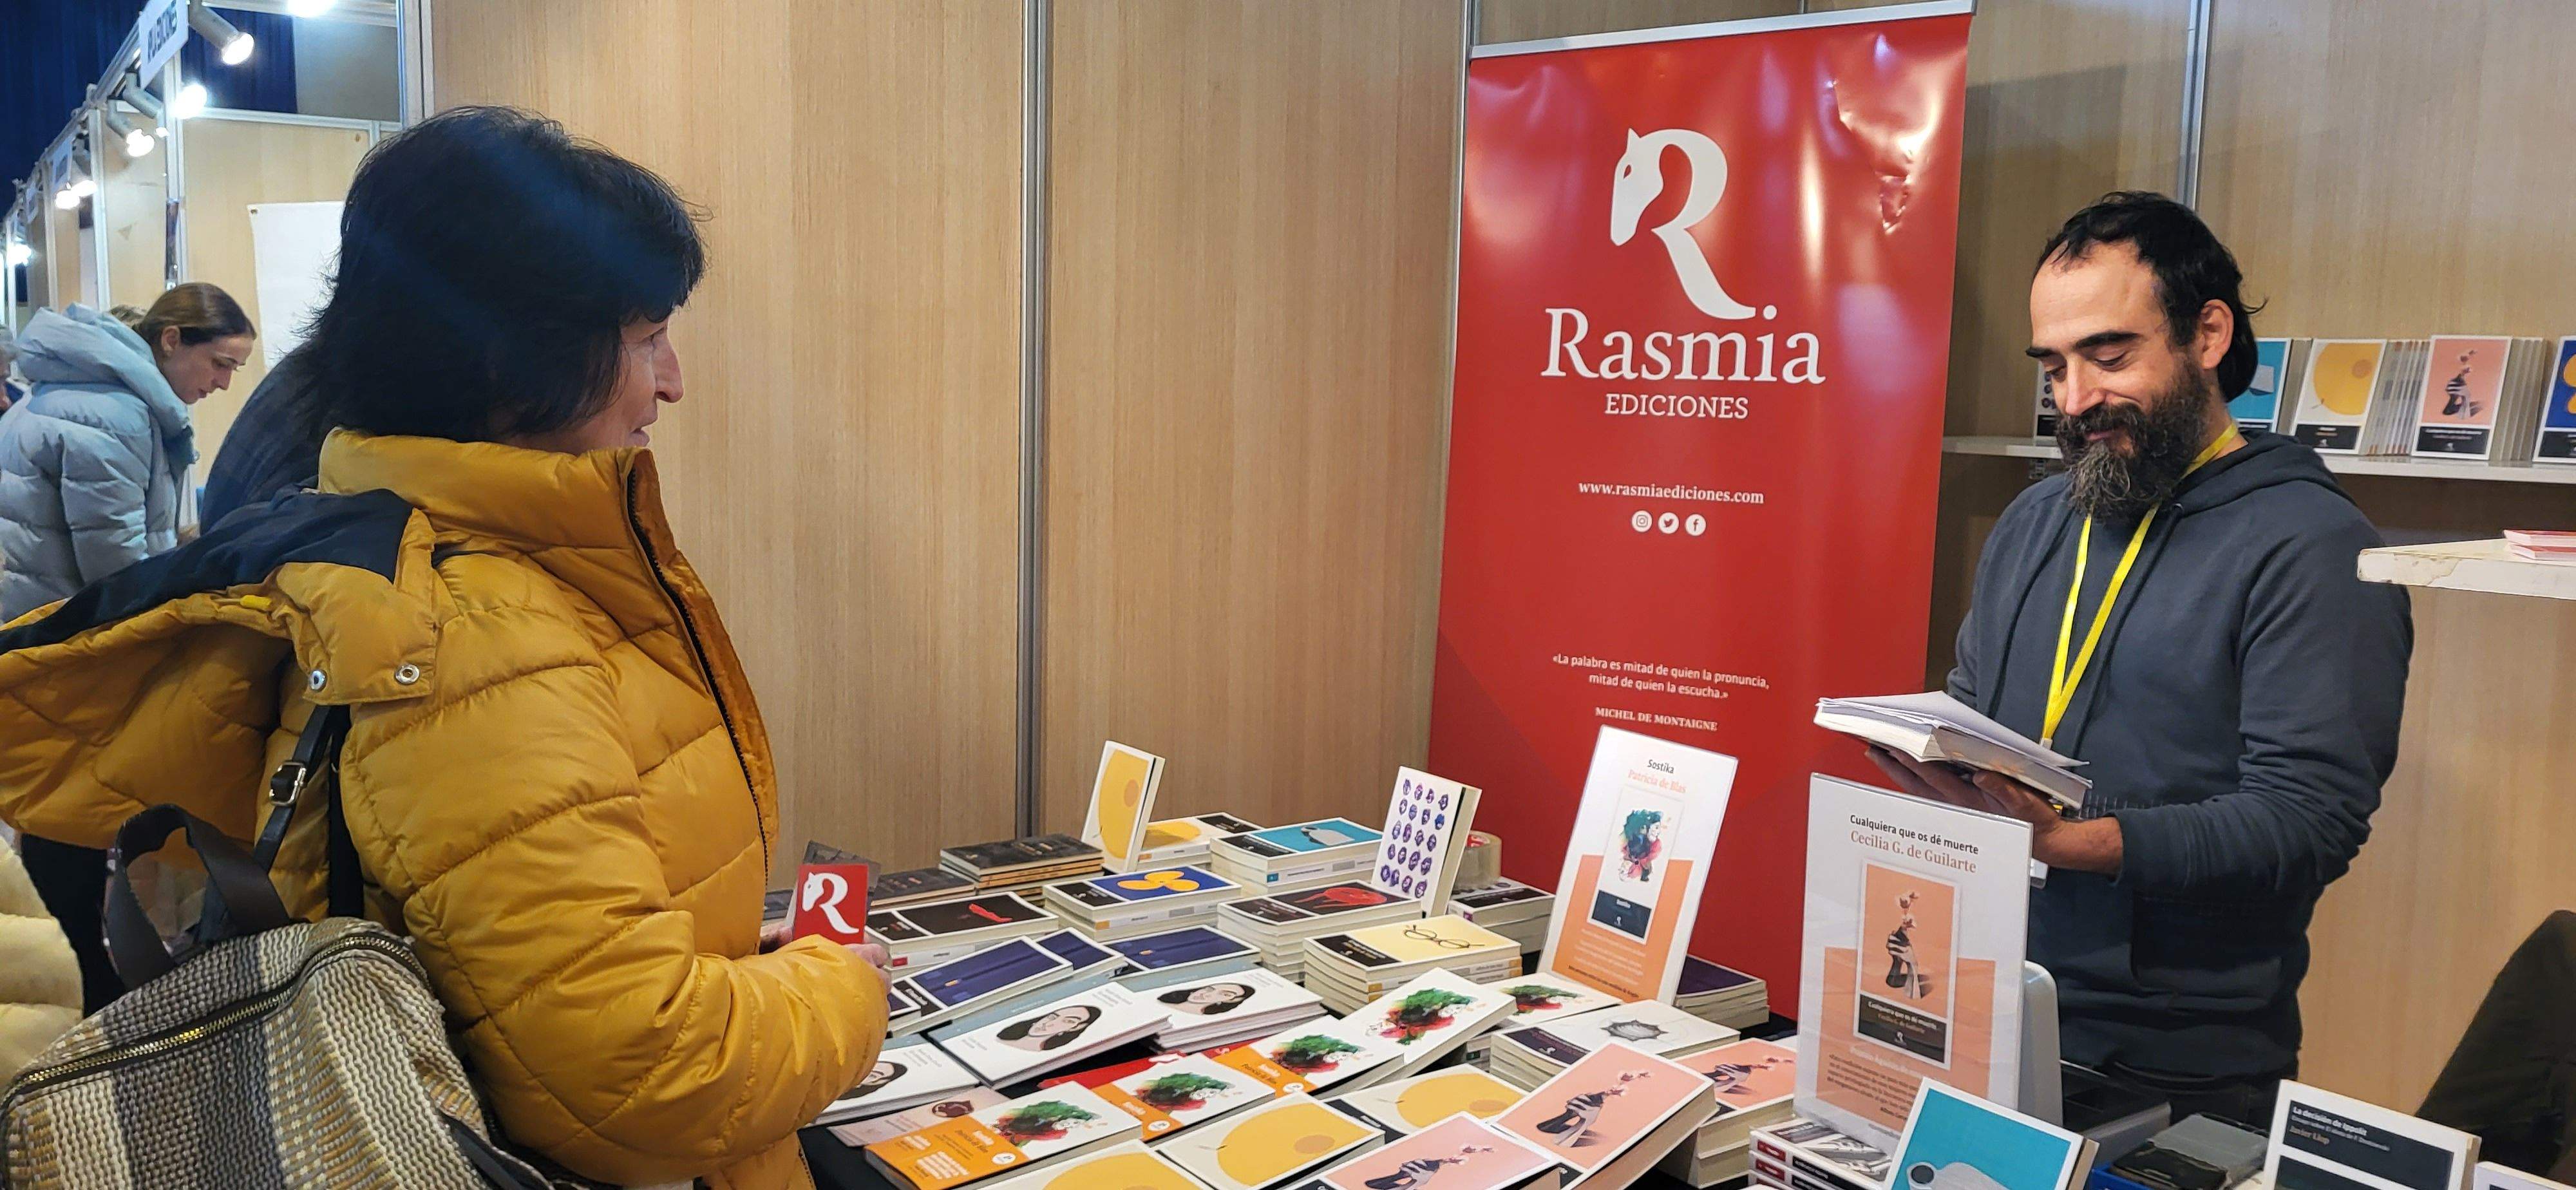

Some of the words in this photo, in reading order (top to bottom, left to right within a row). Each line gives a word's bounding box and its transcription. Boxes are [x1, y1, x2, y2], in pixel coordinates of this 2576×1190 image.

[1540, 305, 1826, 384] Rasmia
[1604, 393, 1749, 419] EDICIONES
[1579, 482, 1765, 504] www.rasmiaediciones.com
[1571, 655, 1608, 669] palabra
[1609, 661, 1622, 670] es
[1624, 661, 1654, 674] mitad
[1656, 664, 1669, 675] de
[1671, 667, 1700, 679] quien
[1702, 669, 1712, 681] la
[1714, 673, 1770, 690] pronuncia,
[1589, 674, 1619, 687] mitad
[1620, 676, 1633, 688] de
[1635, 679, 1665, 691] quien
[1667, 681, 1676, 694] la
[1678, 685, 1729, 699] escucha.»
[1595, 706, 1636, 721] MICHEL
[1638, 712, 1653, 723] DE
[1654, 714, 1718, 732] MONTAIGNE
[1627, 769, 1658, 786] Patricia
[1659, 778, 1669, 789] de
[1647, 759, 1675, 774] Sostika
[1850, 814, 1897, 835] Cualquiera
[1899, 827, 1916, 839] que
[1917, 833, 1928, 842] os
[1930, 833, 1942, 845] dé
[1944, 838, 1979, 855] muerte
[1850, 830, 1889, 851] Cecilia
[1892, 840, 1904, 855] G.
[1907, 844, 1922, 859] de
[1924, 849, 1976, 874] Guilarte
